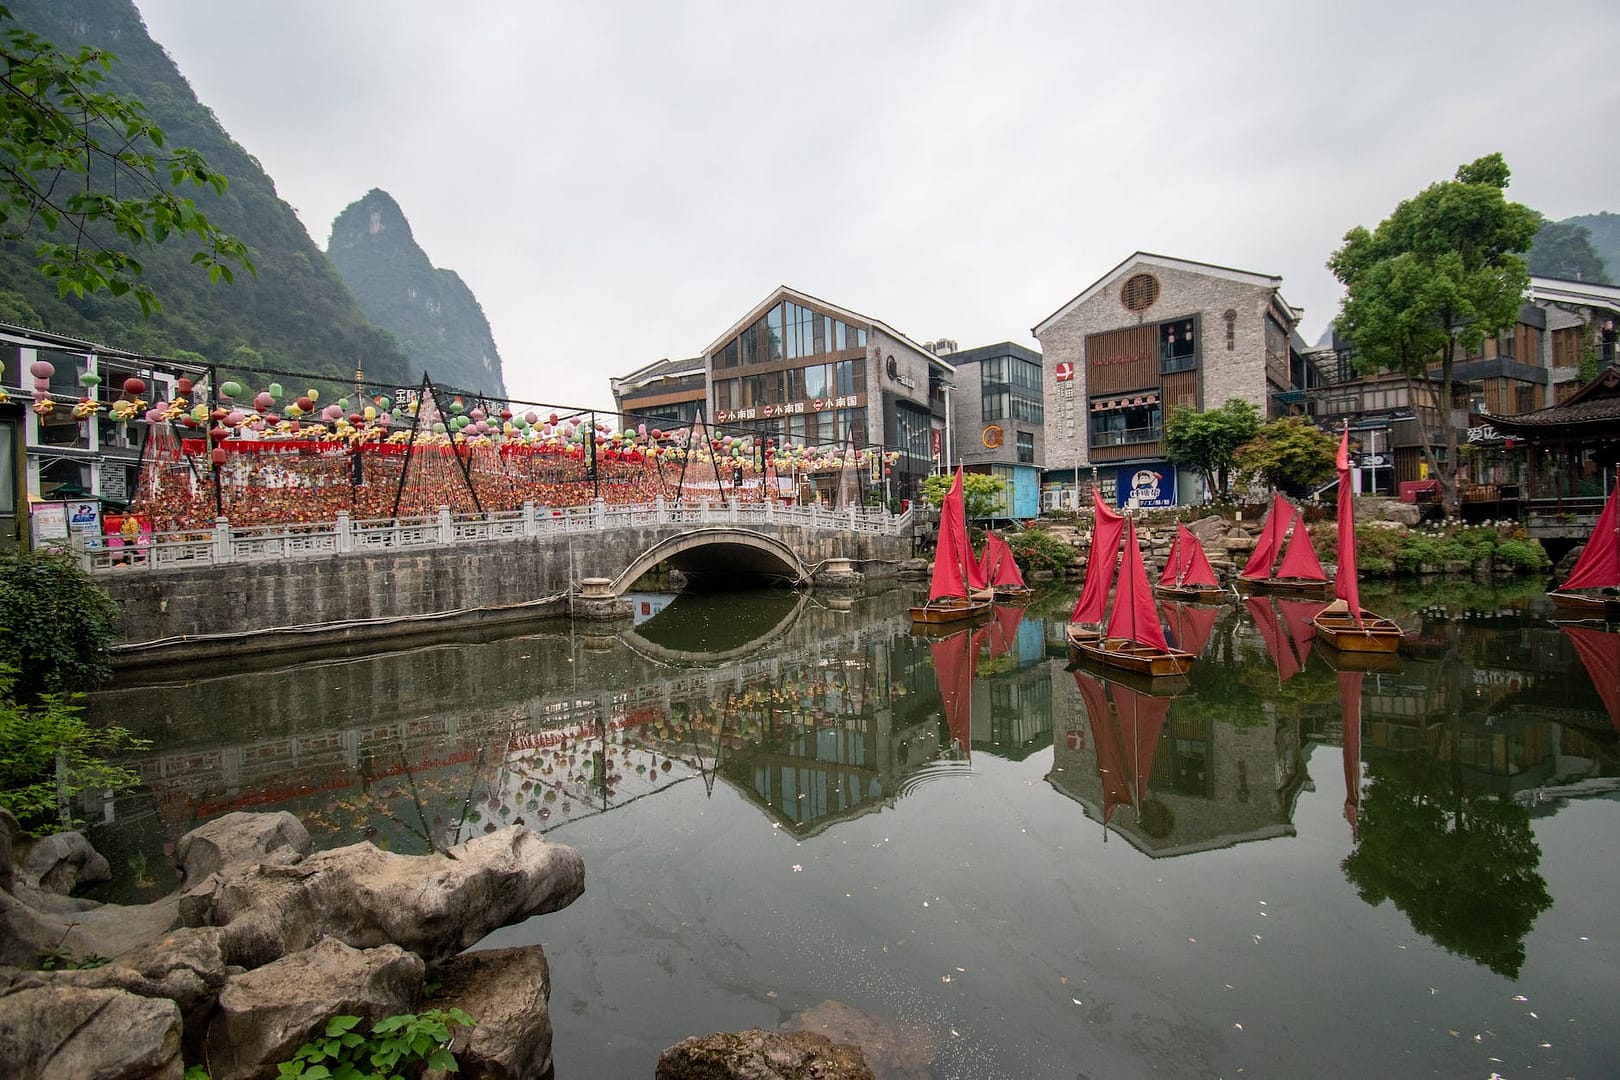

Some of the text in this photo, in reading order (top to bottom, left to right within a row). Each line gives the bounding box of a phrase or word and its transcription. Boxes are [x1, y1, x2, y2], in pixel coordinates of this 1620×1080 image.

[774, 402, 804, 416] 小南国
[825, 395, 857, 409] 小南国
[728, 408, 756, 421] 小南国
